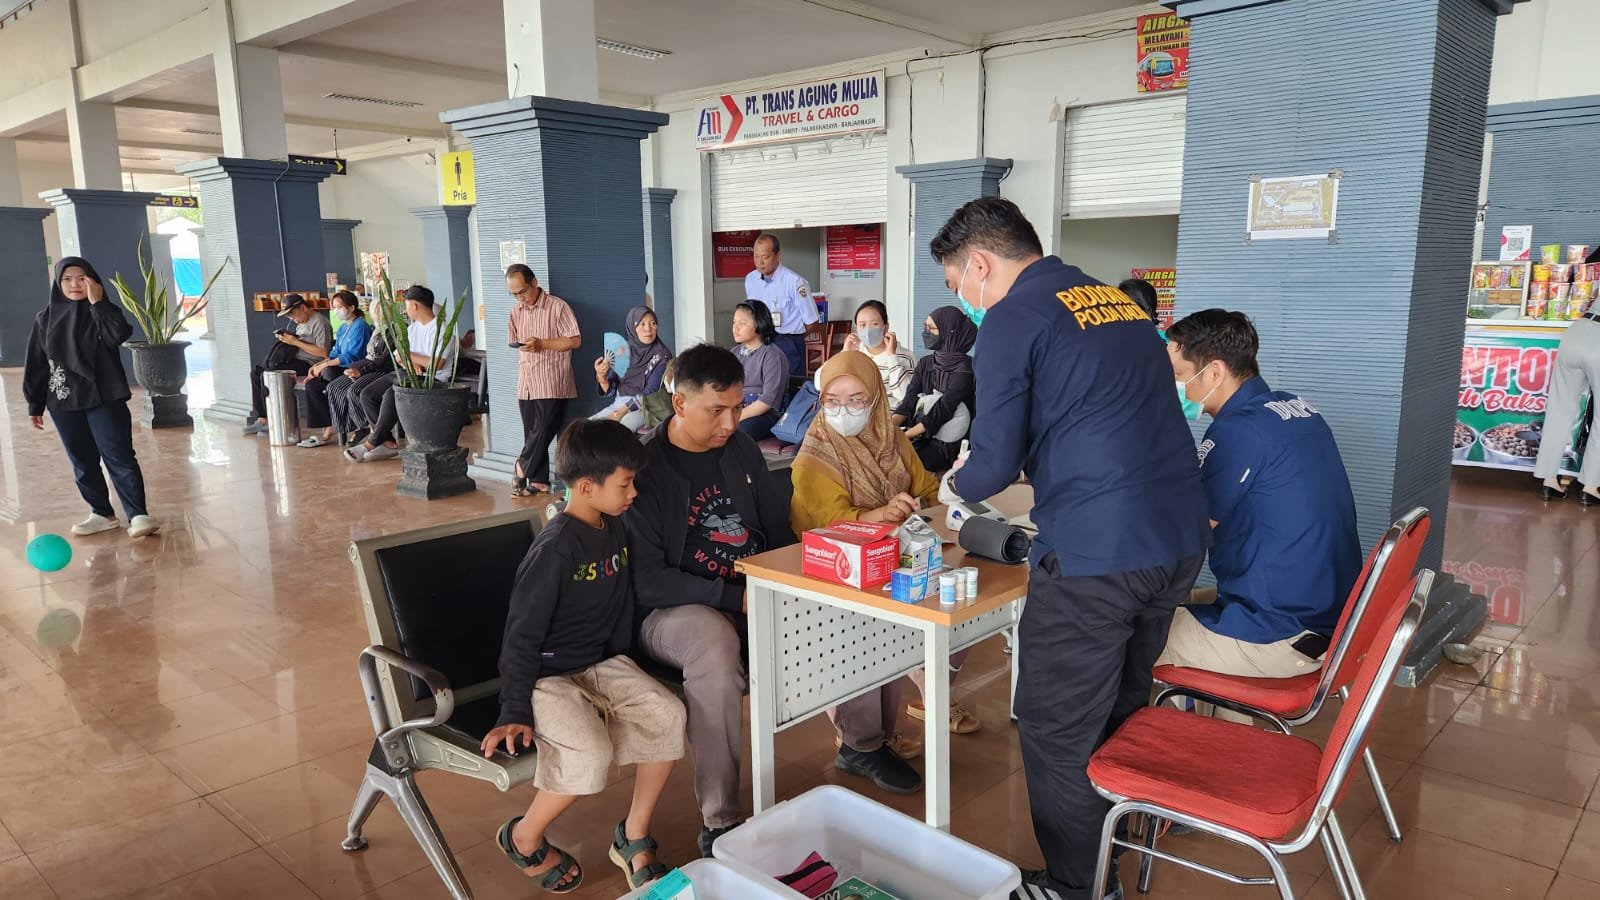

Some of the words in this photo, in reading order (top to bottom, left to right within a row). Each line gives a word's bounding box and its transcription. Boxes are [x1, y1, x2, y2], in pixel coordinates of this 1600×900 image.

[1143, 15, 1187, 32] AIRGA
[745, 96, 759, 115] PT.
[762, 90, 795, 113] TRANS
[798, 83, 838, 108] AGUNG
[841, 77, 878, 102] MULIA
[762, 112, 803, 127] TRAVEL
[806, 110, 814, 122] &
[817, 103, 860, 121] CARGO
[453, 190, 468, 201] Pria
[1143, 271, 1176, 280] AIRGA
[1482, 389, 1547, 412] Baks
